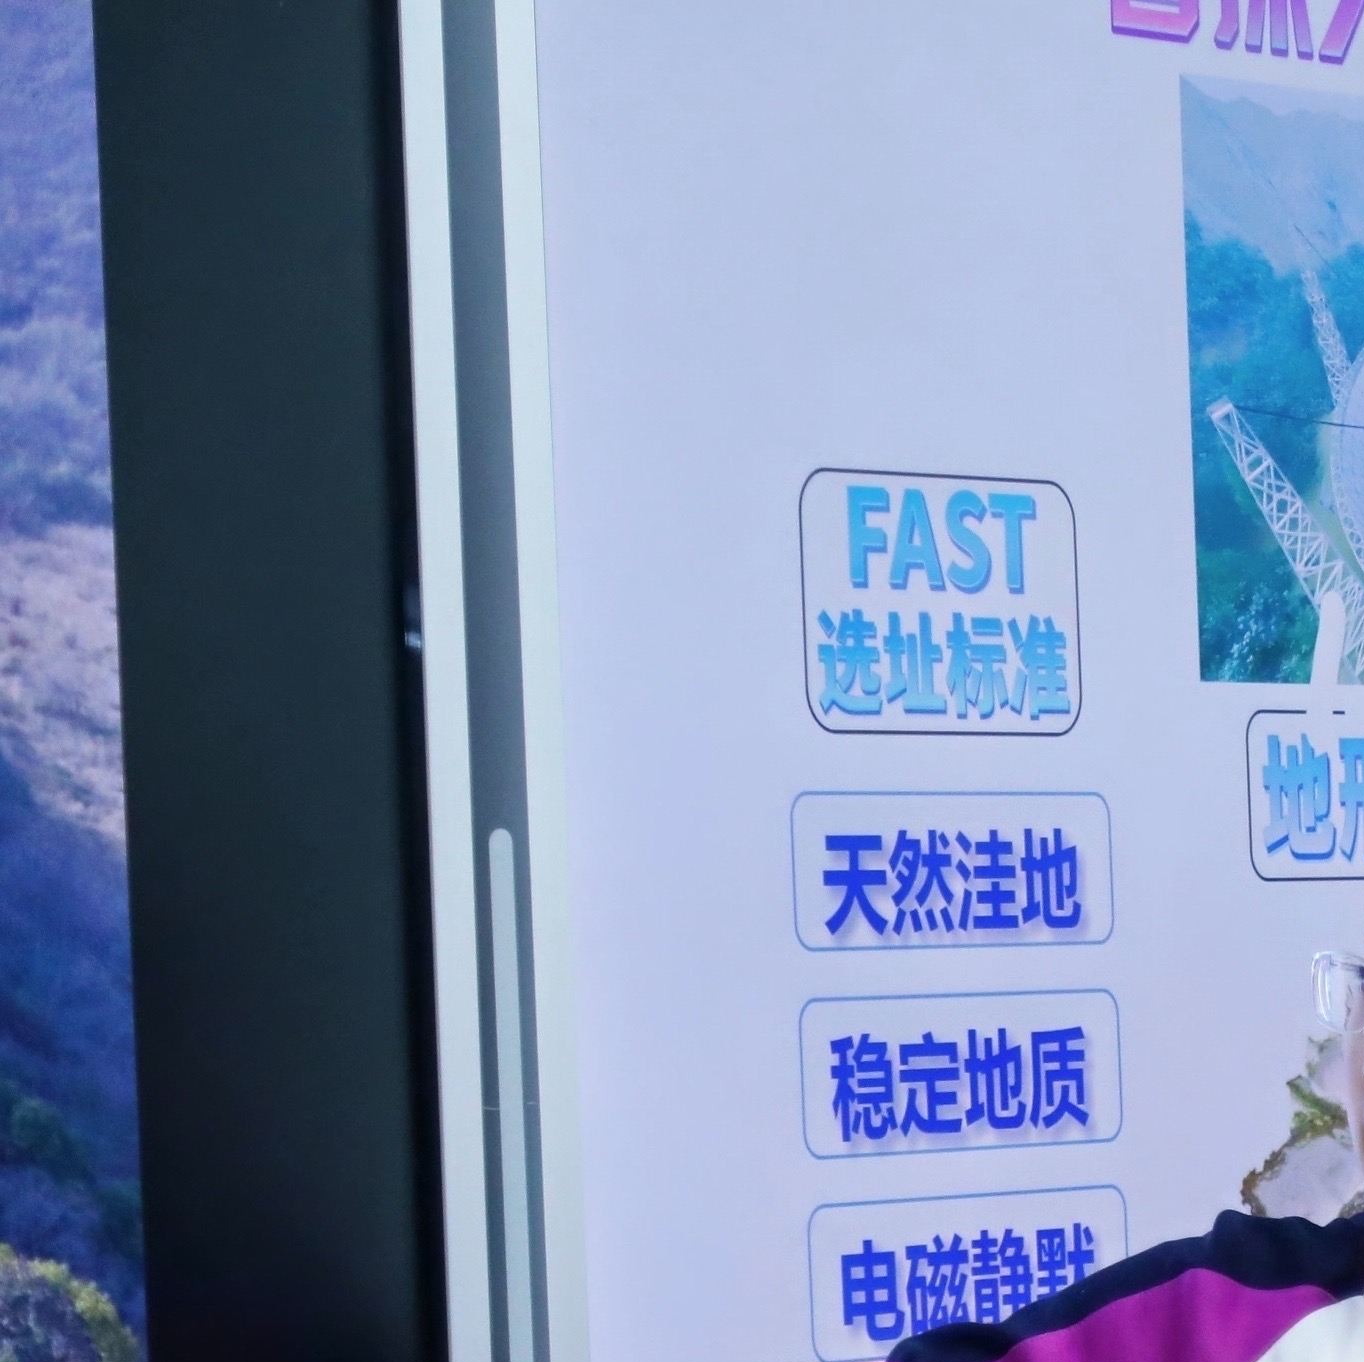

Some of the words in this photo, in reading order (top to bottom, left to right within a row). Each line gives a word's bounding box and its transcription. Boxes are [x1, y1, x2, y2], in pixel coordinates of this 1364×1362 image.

[846, 485, 1037, 594] FAST
[817, 608, 1071, 721] 选址标准
[822, 828, 1082, 937] 天然洼地
[829, 1026, 1090, 1142] 稳定地质
[840, 1222, 1096, 1342] 电磁静默
